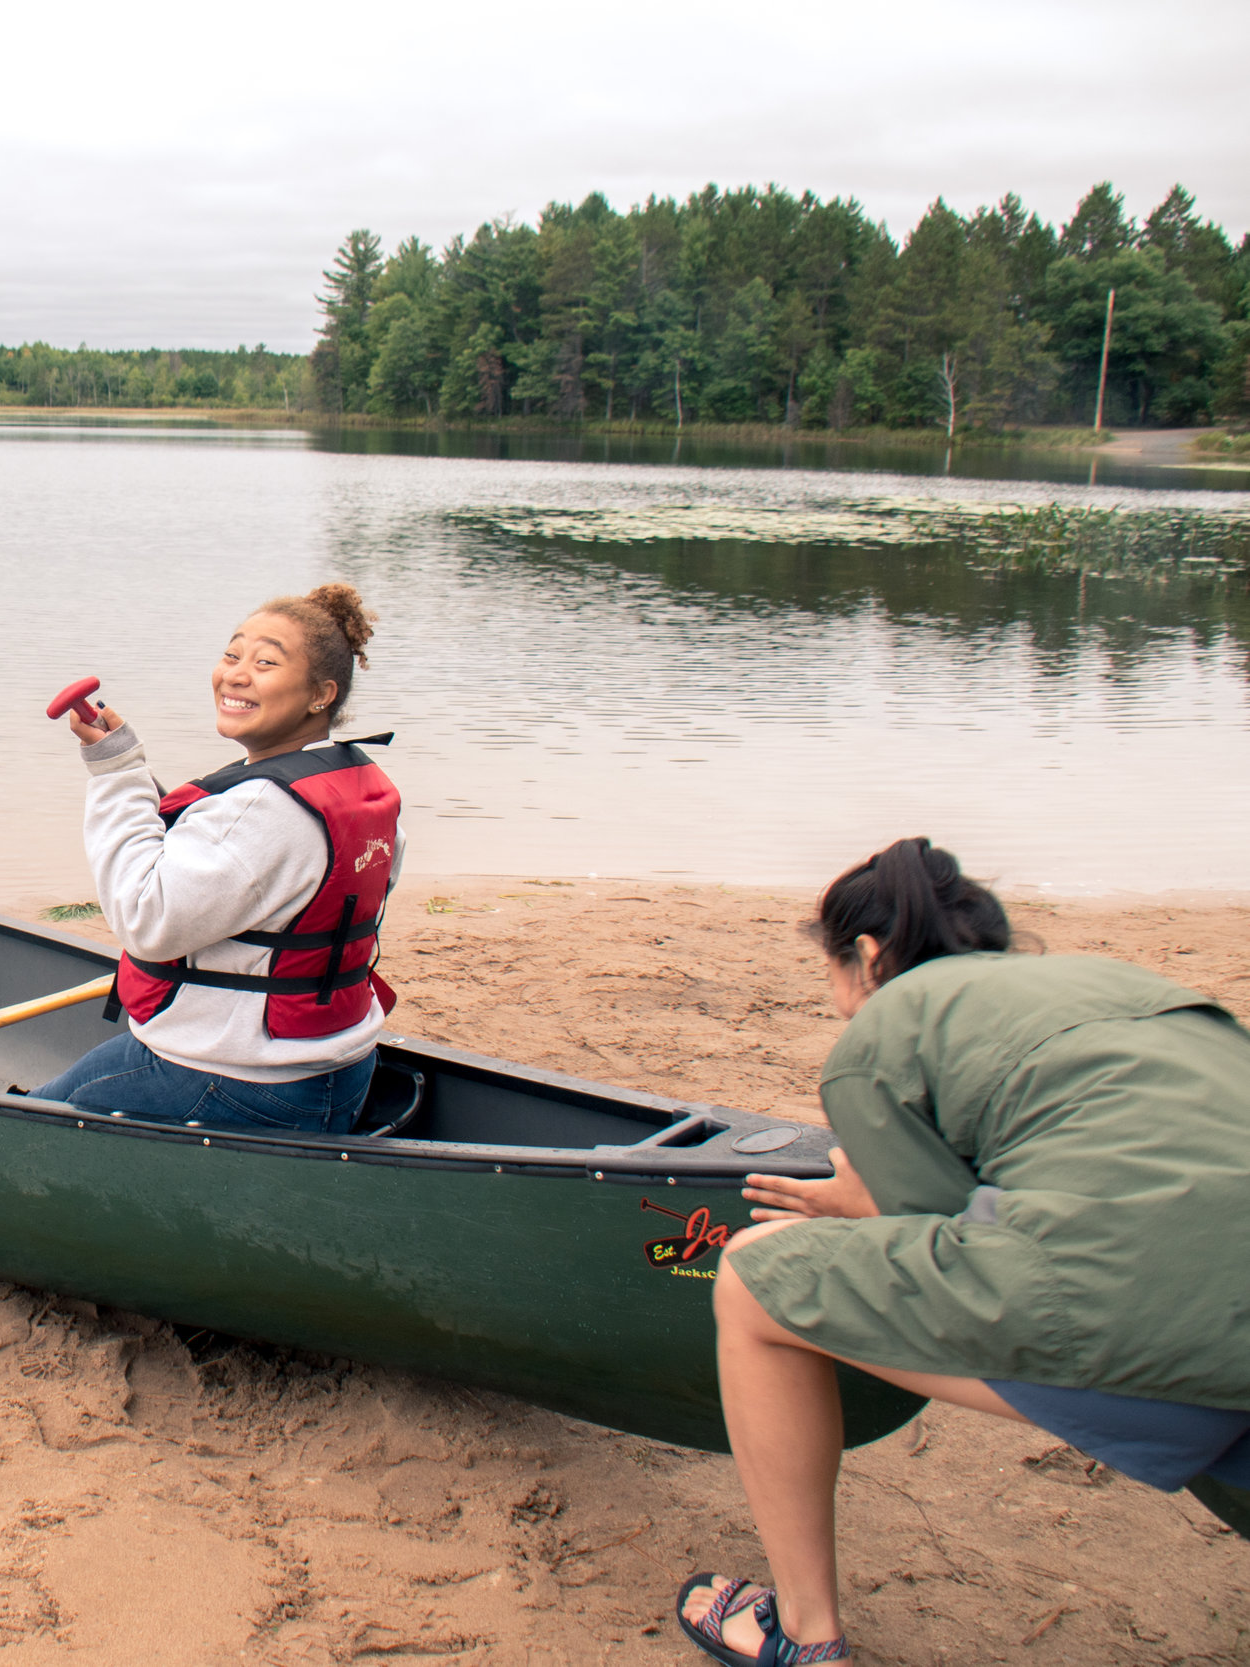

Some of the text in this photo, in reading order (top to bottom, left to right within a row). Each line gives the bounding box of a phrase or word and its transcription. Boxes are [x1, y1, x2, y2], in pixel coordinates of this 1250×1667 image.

[682, 1207, 739, 1260] Ja
[653, 1244, 676, 1260] Est.
[670, 1265, 718, 1280] JacksC
